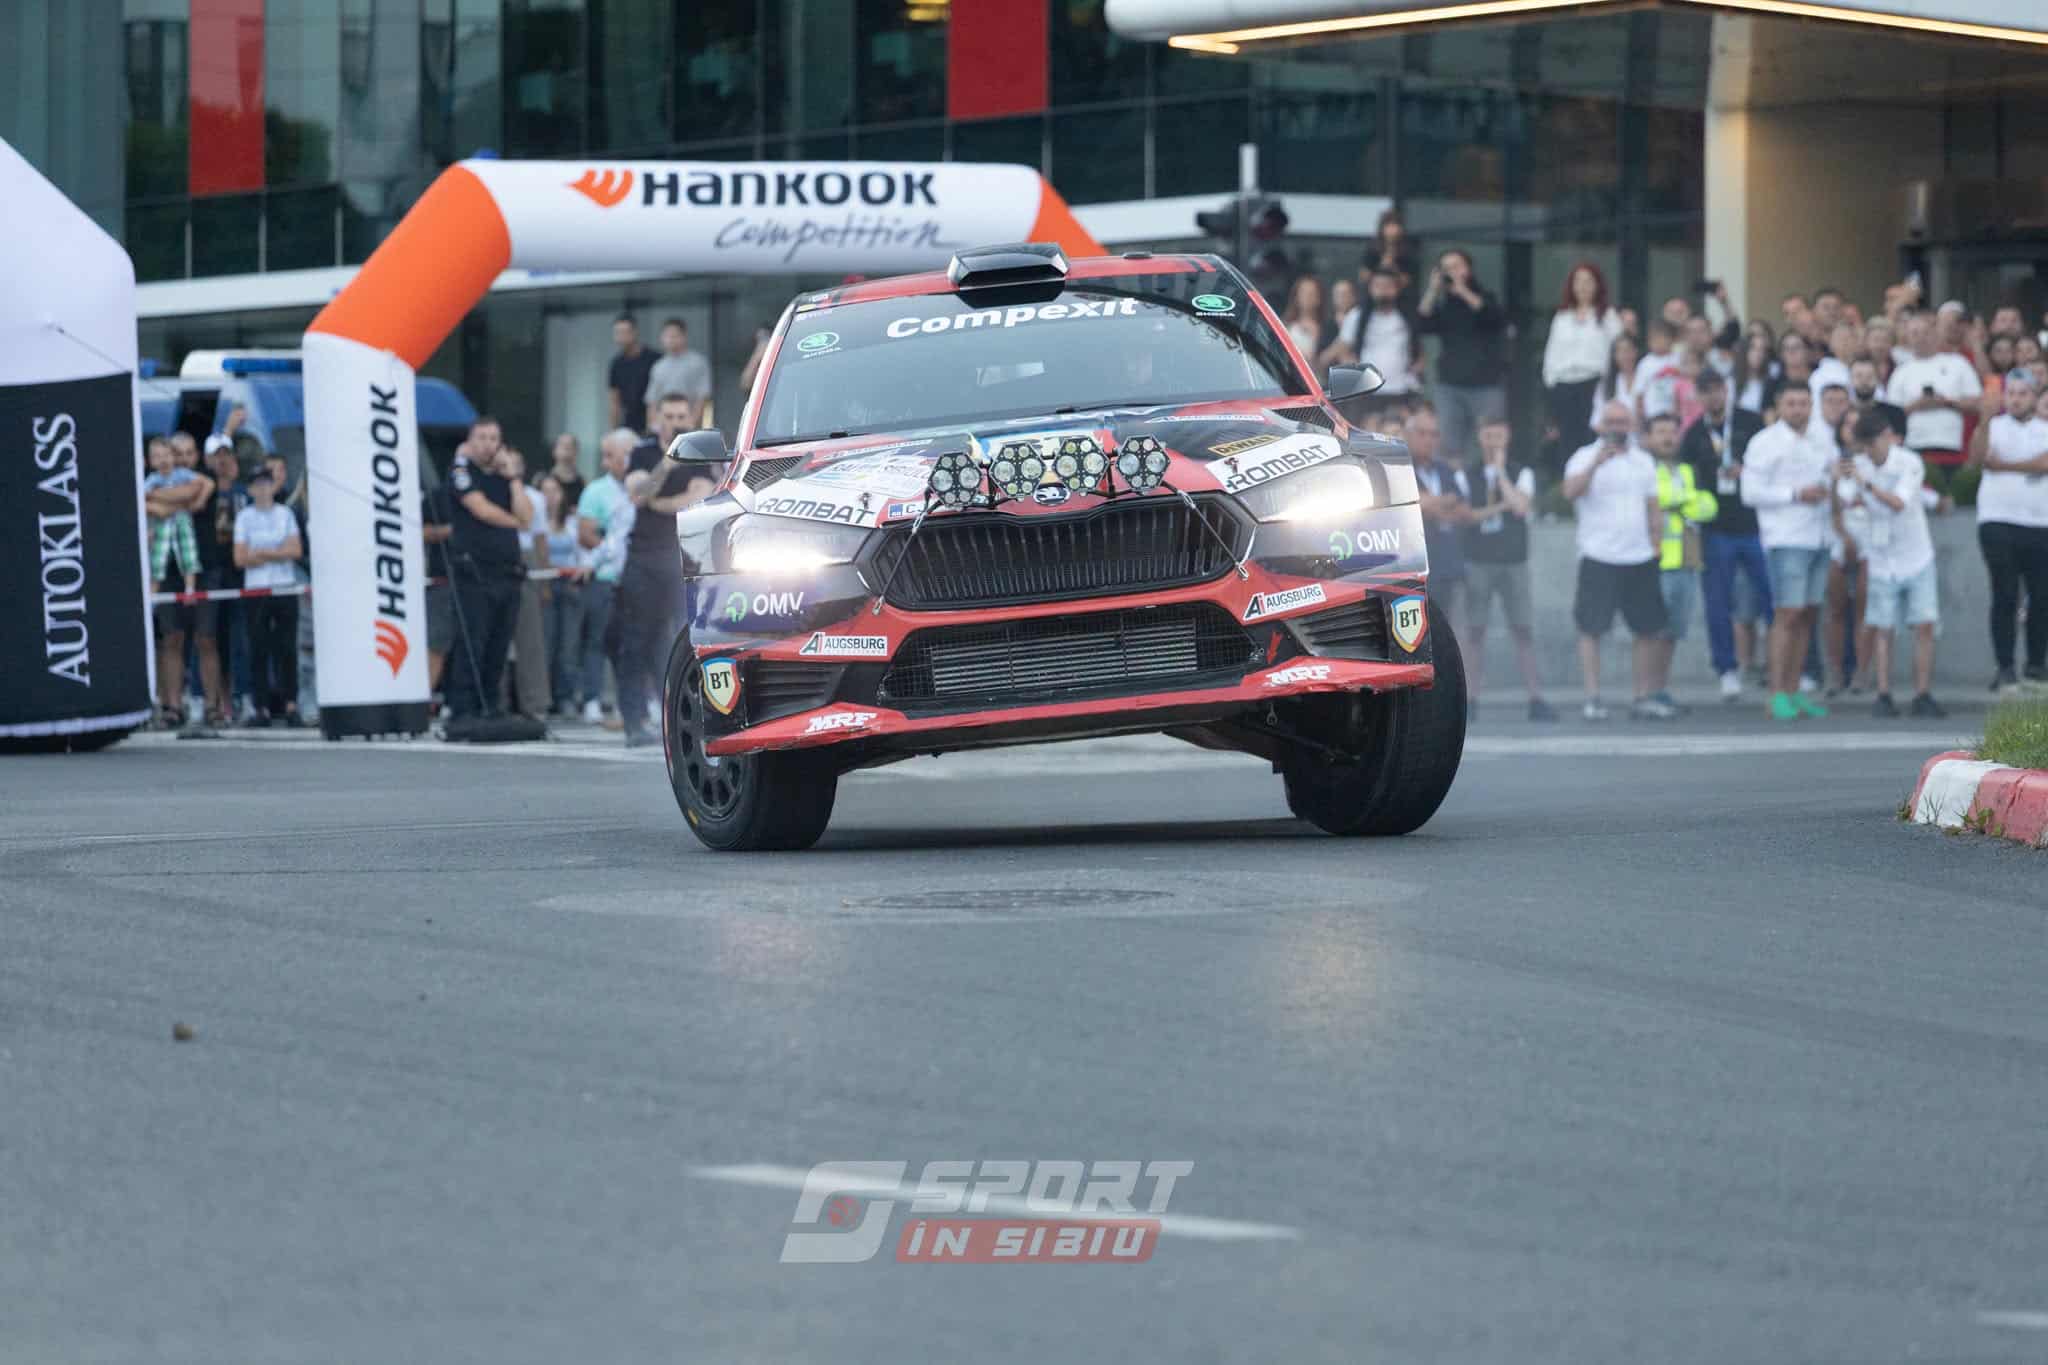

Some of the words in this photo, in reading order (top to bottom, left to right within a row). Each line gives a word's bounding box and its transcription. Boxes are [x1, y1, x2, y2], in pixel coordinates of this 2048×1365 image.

[1228, 444, 1329, 490] ROMBAT
[758, 497, 876, 524] ROMBAT
[32, 413, 91, 689] AUTOKLASS
[1357, 528, 1401, 552] OMV
[753, 591, 804, 616] OMV
[1266, 586, 1322, 609] AUGSBURG
[1400, 608, 1419, 628] BT
[824, 638, 885, 649] AUGSBURG
[710, 670, 731, 689] BT
[1264, 665, 1331, 686] MRF
[805, 712, 877, 733] MRF
